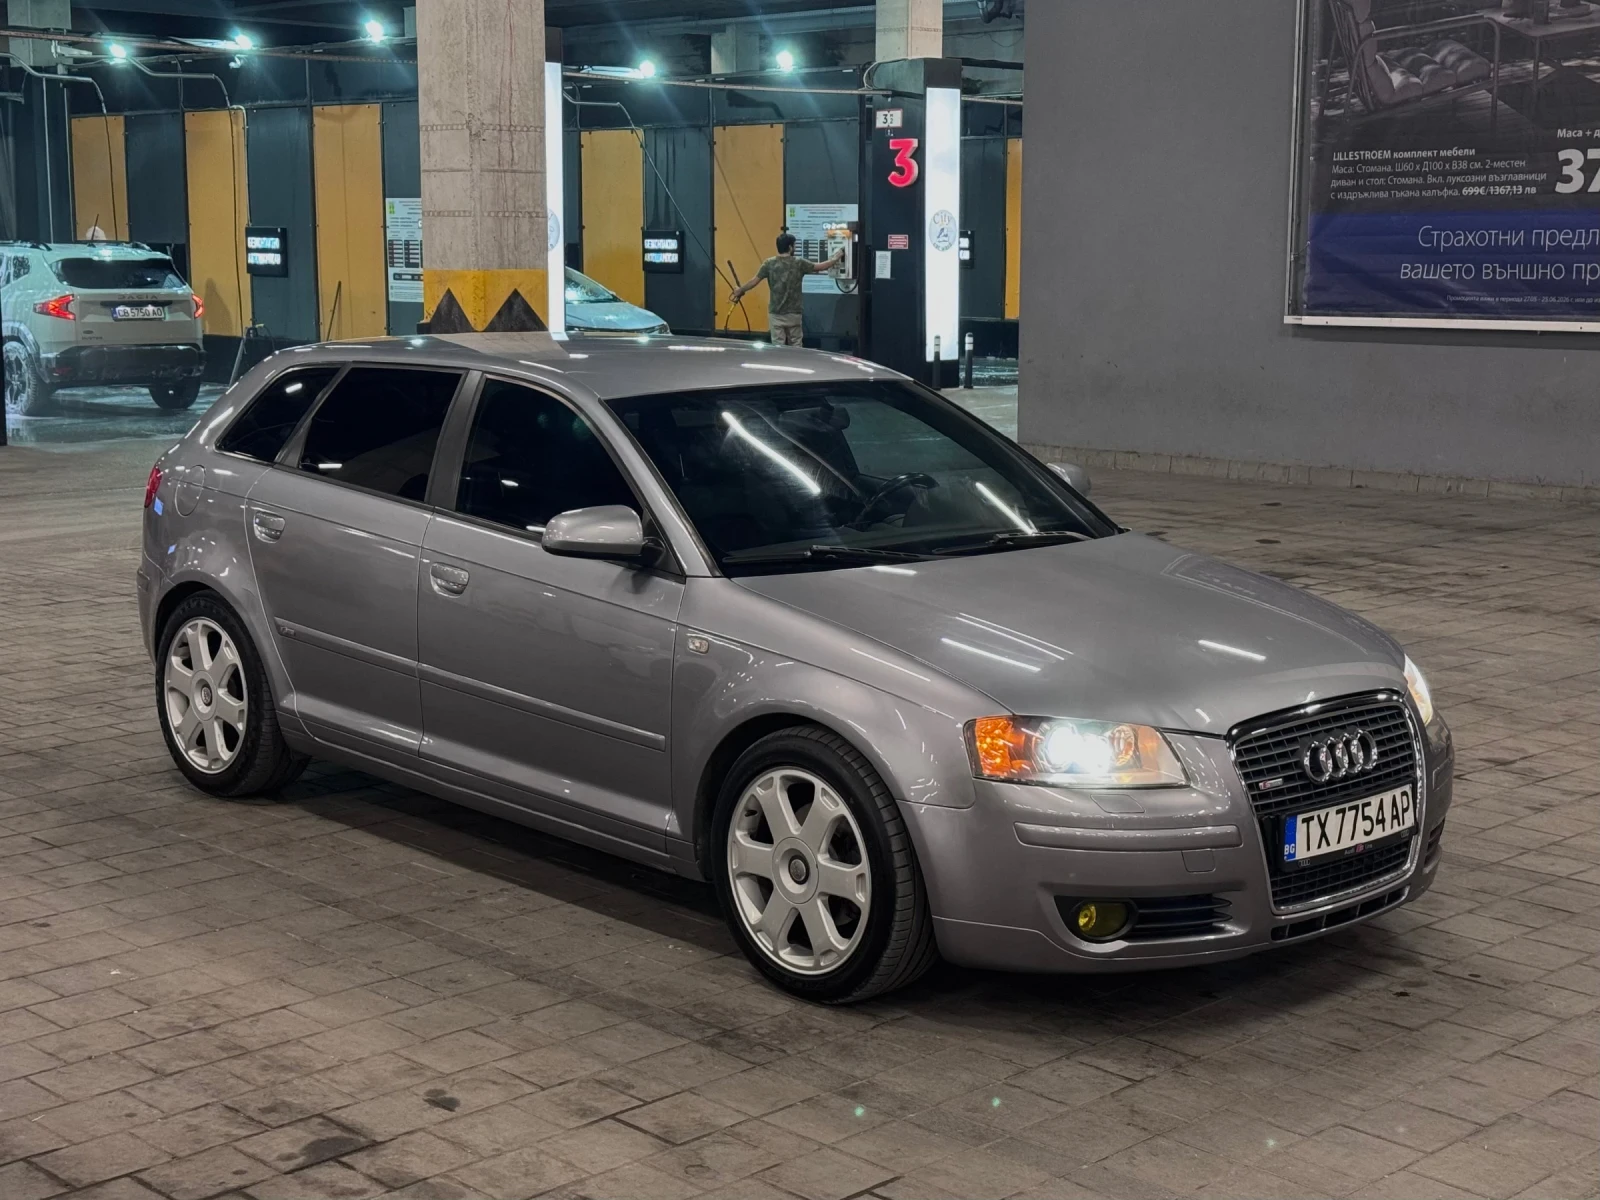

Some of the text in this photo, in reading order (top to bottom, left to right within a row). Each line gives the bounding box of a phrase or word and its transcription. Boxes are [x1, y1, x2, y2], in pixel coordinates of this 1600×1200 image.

[883, 114, 888, 124] 3
[1557, 129, 1583, 139] Маса
[1393, 149, 1438, 160] комплект
[1440, 147, 1475, 158] мебели
[888, 138, 919, 187] 3
[1332, 164, 1355, 174] Маса:
[1395, 162, 1413, 172] Ш60
[1422, 161, 1443, 172] Д100
[1485, 159, 1526, 169] 2-местен
[1331, 178, 1356, 188] диван
[1427, 174, 1445, 184] Вкл.
[1446, 173, 1487, 186] луксозни
[1488, 171, 1547, 183] възглавници
[1338, 190, 1389, 201] издръжлива
[1391, 189, 1420, 198] тъкана
[1524, 187, 1537, 195] лв
[1418, 225, 1600, 252] Страхотни предл
[1400, 263, 1600, 286] вашето външно пр
[1302, 790, 1410, 852] TX 7754 AP
[1284, 843, 1296, 855] BG
